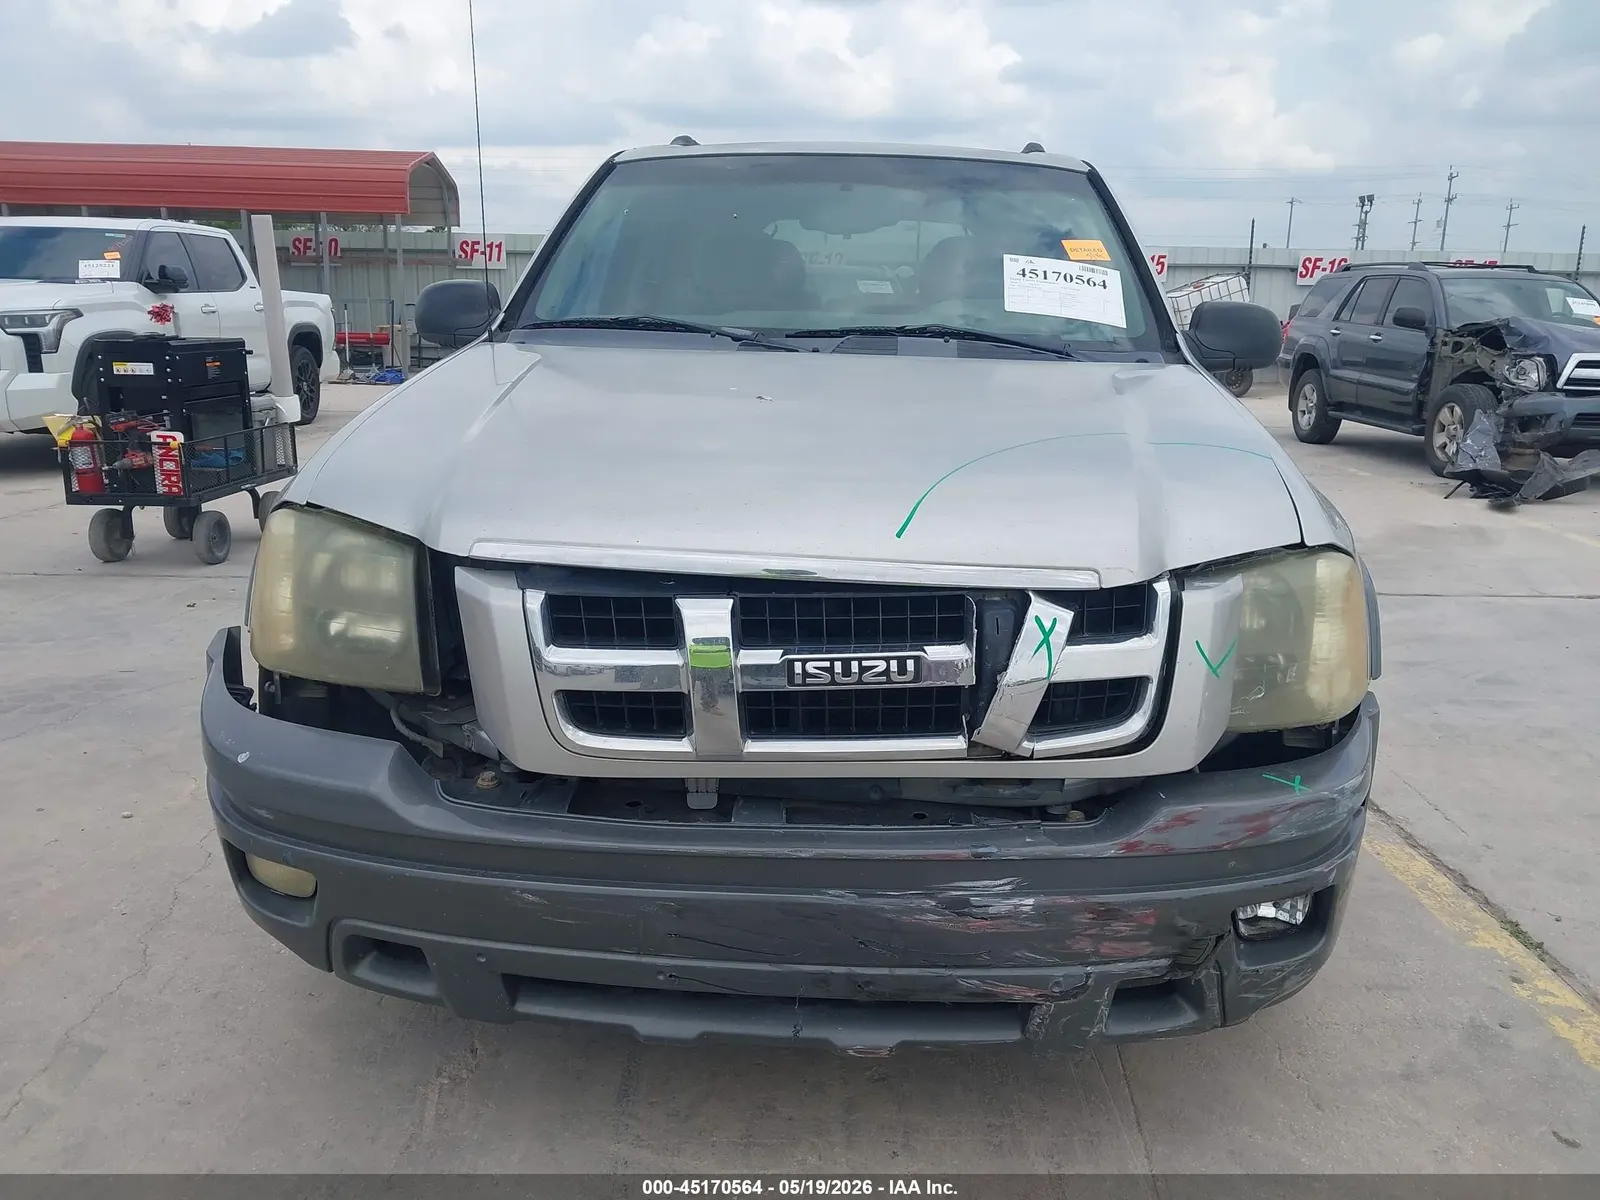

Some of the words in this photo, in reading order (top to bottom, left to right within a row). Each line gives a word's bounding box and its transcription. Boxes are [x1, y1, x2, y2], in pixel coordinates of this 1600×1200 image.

[459, 240, 503, 262] SF-11
[1016, 268, 1108, 290] 45170564
[794, 659, 915, 684] ISUZU
